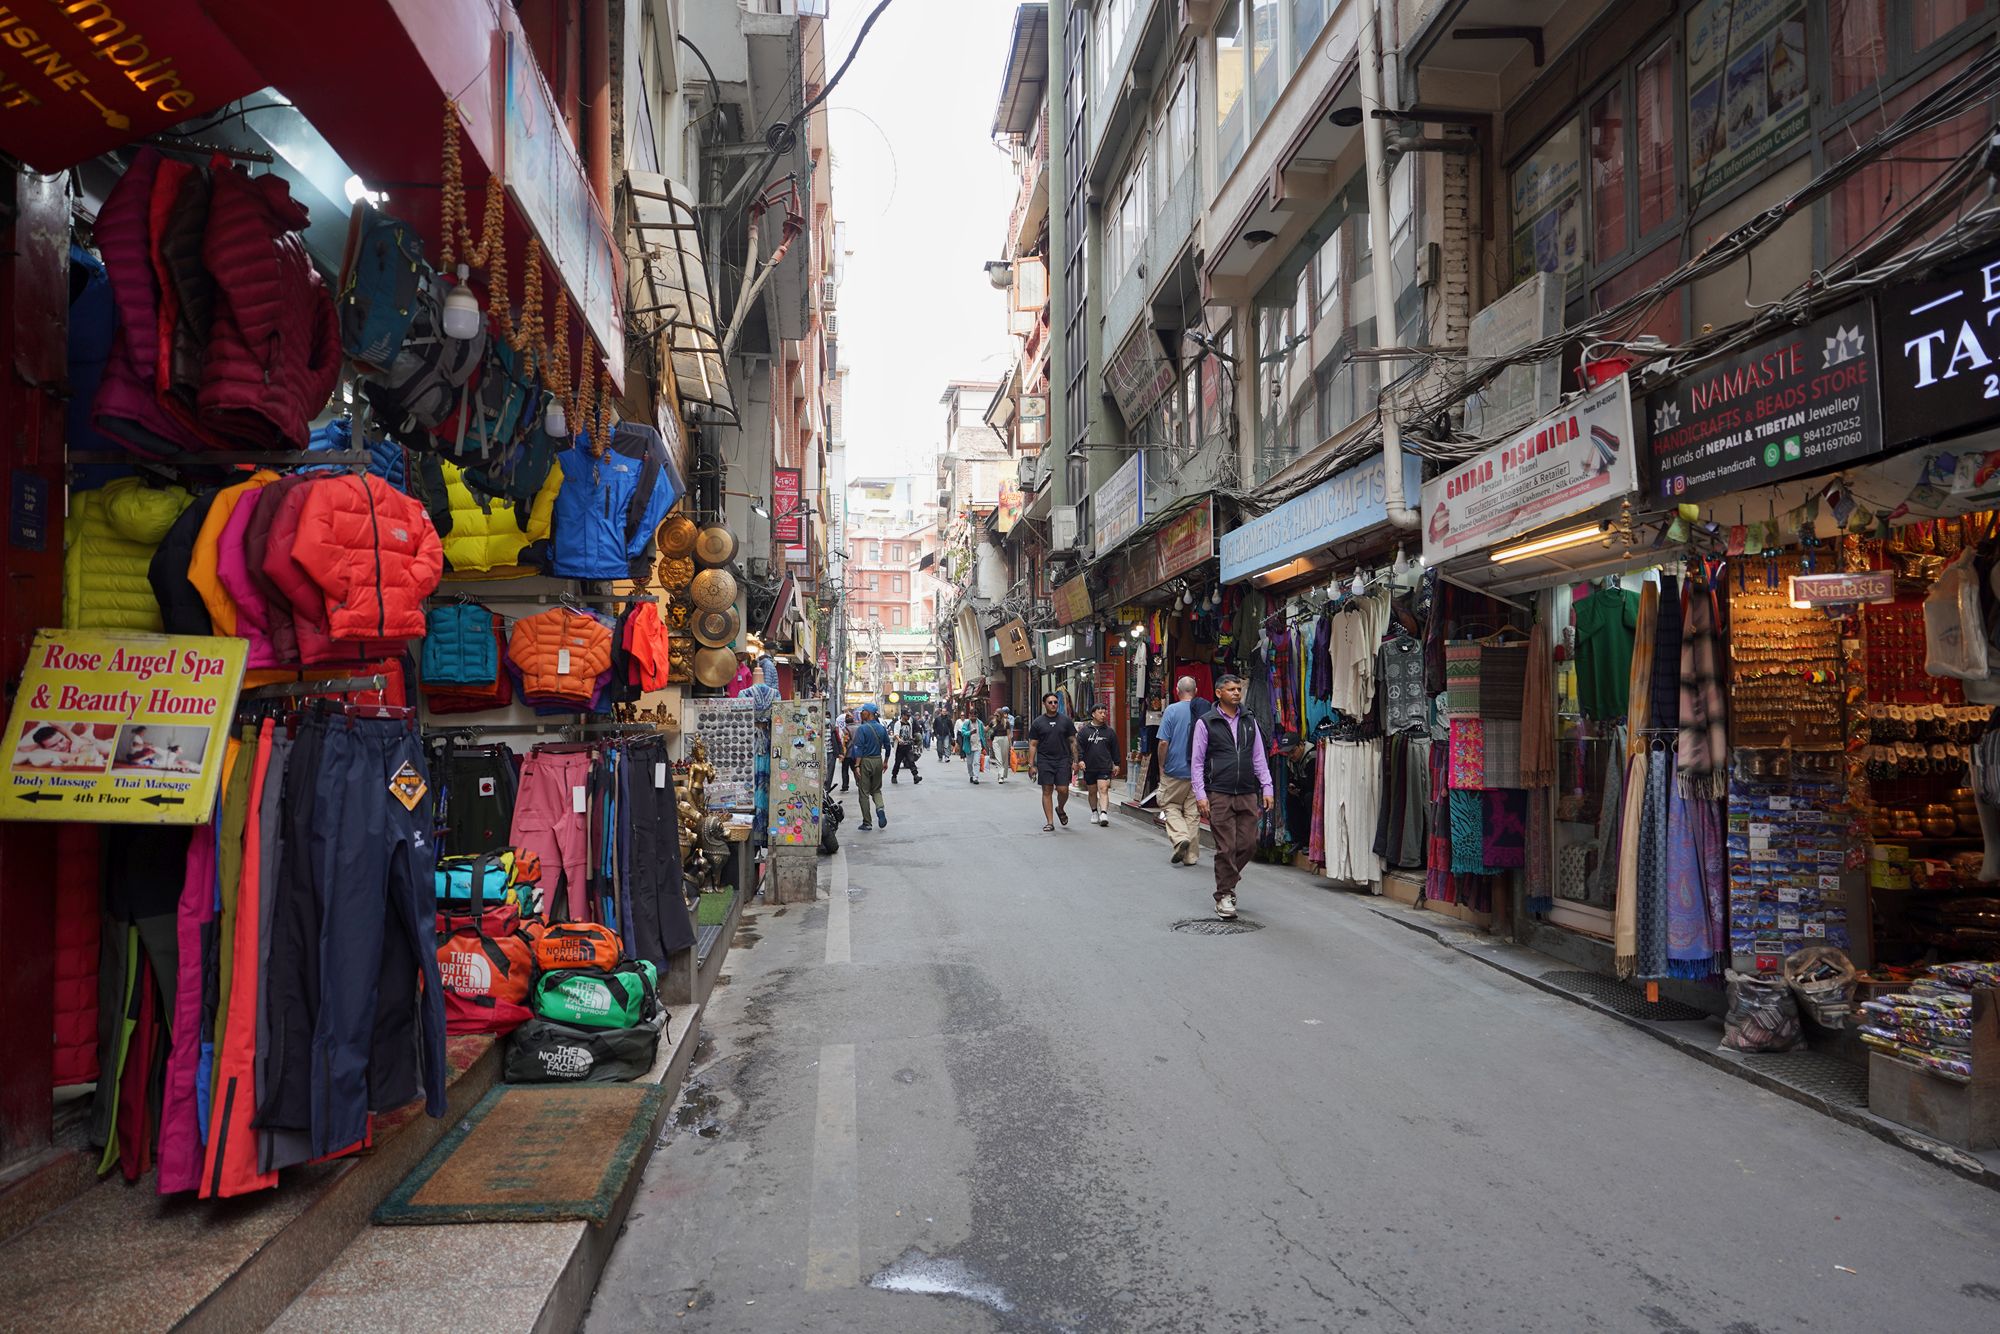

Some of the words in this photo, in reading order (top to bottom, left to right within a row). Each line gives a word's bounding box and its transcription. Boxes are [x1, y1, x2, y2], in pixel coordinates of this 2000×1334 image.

[58, 0, 195, 112] mpire
[1694, 168, 1723, 200] Turist
[1723, 137, 1773, 180] Information
[1774, 114, 1806, 145] Center
[1904, 307, 2000, 389] TA
[1691, 342, 1804, 414] NAMASTE
[1654, 408, 1742, 456] HANDICRAFTS
[1744, 410, 1754, 425] &
[1755, 388, 1807, 421] BEADS
[1810, 359, 1869, 402] STORE
[1661, 458, 1671, 472] All
[1673, 449, 1694, 468] Kinds
[1695, 444, 1706, 460] of
[1706, 432, 1743, 457] NEPALI
[1744, 428, 1754, 443] &
[1755, 410, 1806, 441] TIBETAN
[1808, 394, 1860, 425] Jewellery
[1803, 416, 1861, 442] 9841270252
[1446, 460, 1493, 500] GAURAB
[1502, 415, 1580, 473] PASHMINA
[1804, 432, 1862, 458] 9841697060
[1686, 467, 1716, 488] Namaste
[1717, 456, 1756, 481] Handicraft
[1281, 508, 1292, 545] &
[1293, 462, 1387, 541] HANDICRAFTS
[1467, 496, 1499, 516] Manufacturer
[1533, 476, 1539, 485] &
[1540, 465, 1568, 484] Retailer
[1495, 500, 1518, 517] Pashmina
[1522, 489, 1551, 509] Cashmere
[1555, 479, 1568, 492] Silk
[1800, 578, 1886, 599] Namaste
[42, 644, 102, 671] Rose
[107, 648, 177, 681] Angel
[181, 650, 225, 683] Spa
[30, 684, 51, 710] &
[57, 685, 142, 721] Beauty
[146, 688, 217, 715] Home
[13, 775, 44, 789] Body
[49, 777, 97, 788] Massage
[114, 778, 141, 788] Thai
[144, 779, 191, 791] Massage
[73, 792, 94, 803] 4th
[98, 793, 131, 804] Floor
[546, 947, 578, 956] NORTH
[561, 939, 579, 947] THE
[450, 951, 472, 964] THE
[554, 954, 579, 963] FACE
[441, 974, 469, 988] FACE
[575, 980, 594, 991] THE
[538, 1050, 576, 1066] NORTH
[557, 1045, 578, 1057] THE
[547, 1061, 574, 1072] FACE
